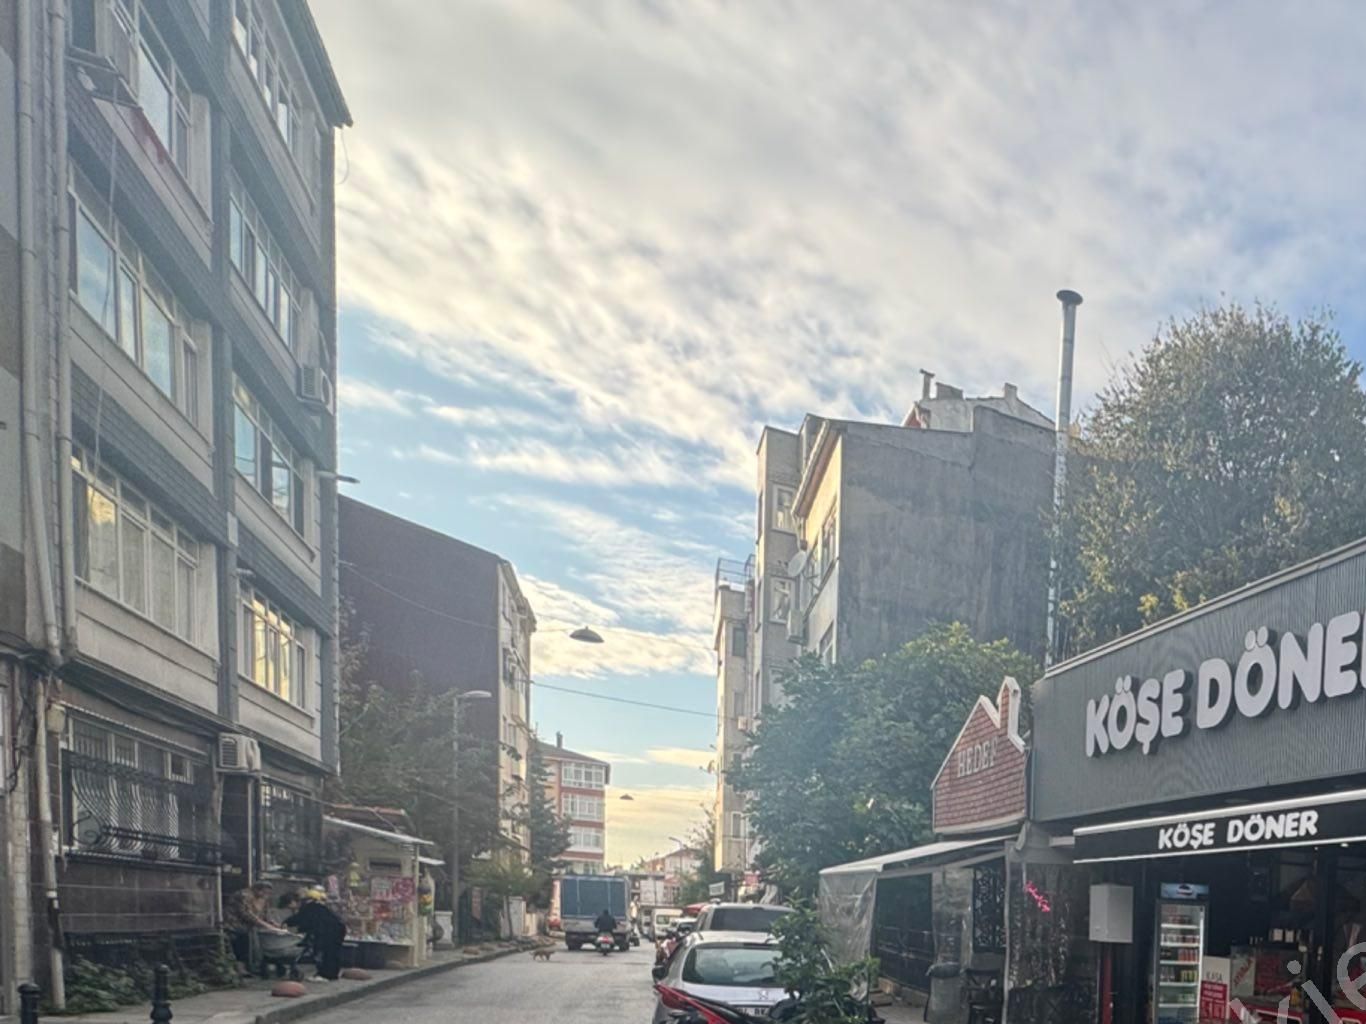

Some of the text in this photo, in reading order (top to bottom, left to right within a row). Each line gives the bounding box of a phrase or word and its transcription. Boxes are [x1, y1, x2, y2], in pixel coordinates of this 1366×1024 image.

[1086, 668, 1187, 756] KÖŞE
[1157, 810, 1318, 850] KÖŞE DÖNER
